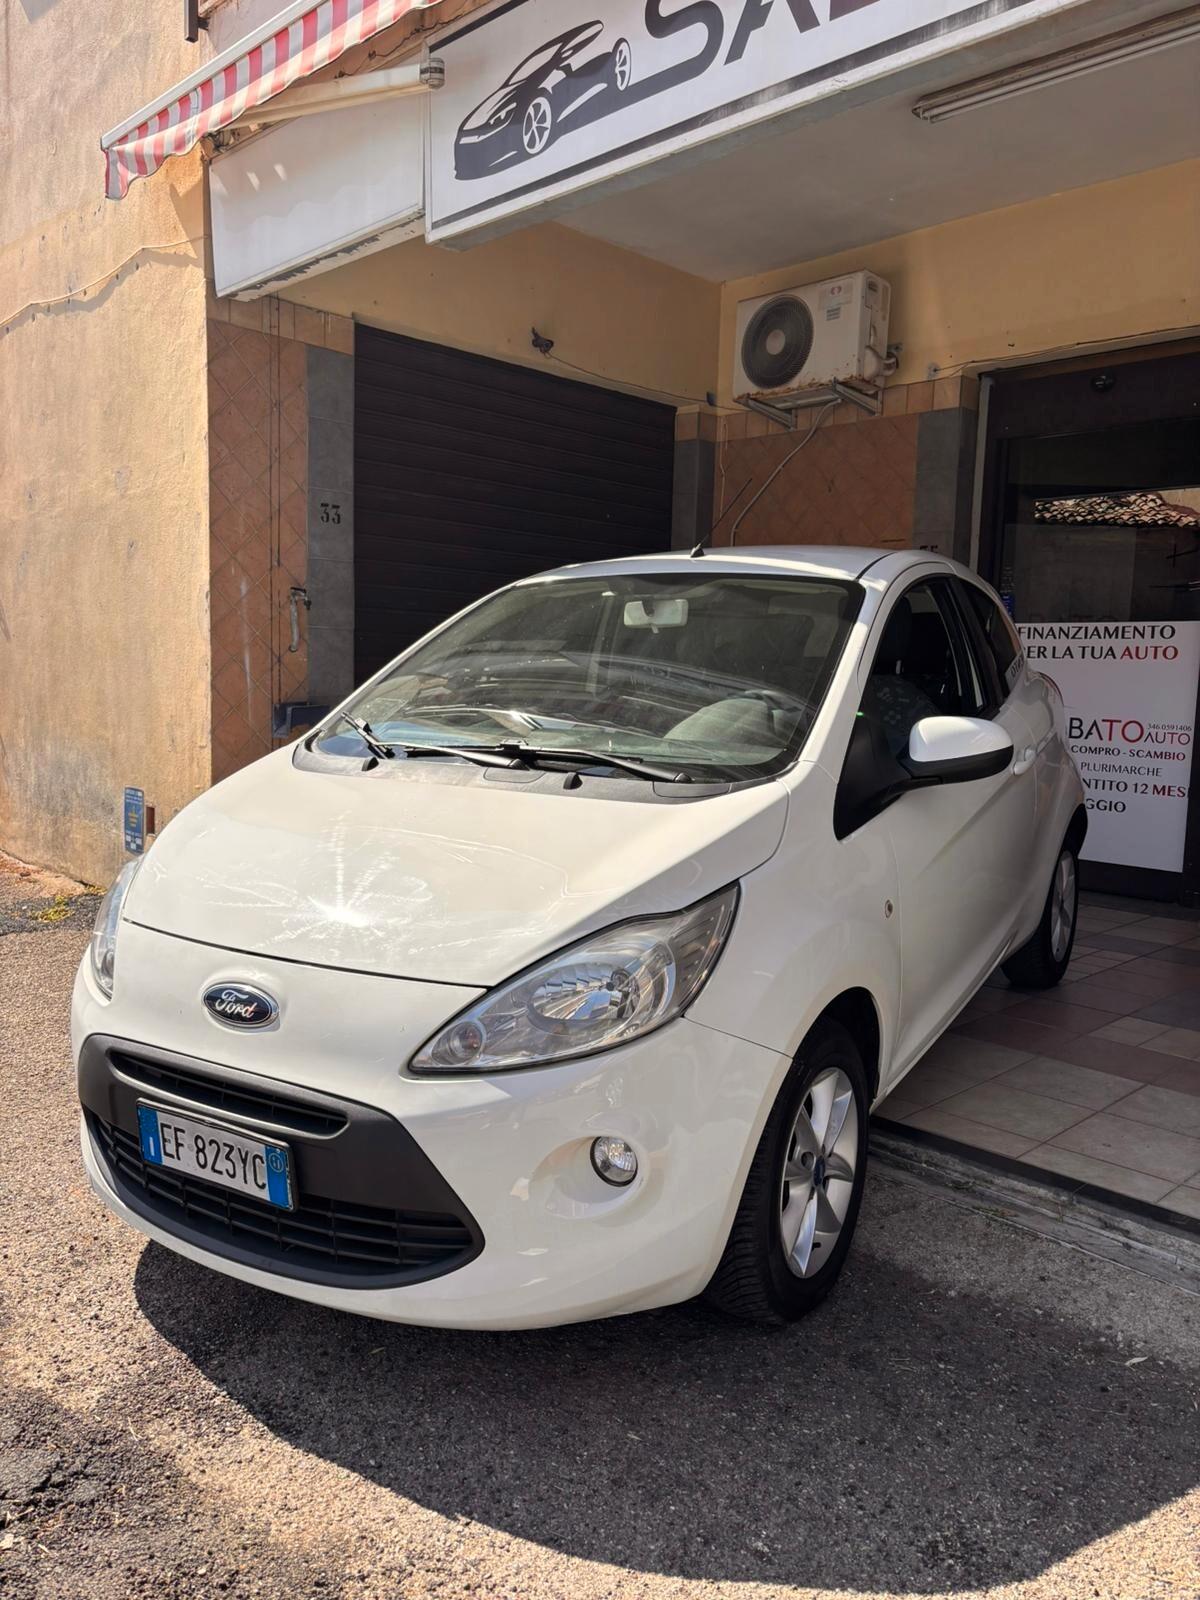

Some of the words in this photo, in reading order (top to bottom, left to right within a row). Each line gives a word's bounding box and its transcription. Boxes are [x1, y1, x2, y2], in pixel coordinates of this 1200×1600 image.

[320, 502, 341, 525] 33
[1018, 624, 1176, 640] FINANZIAMENTO
[1024, 645, 1047, 660] ER
[1052, 645, 1074, 660] LA
[1078, 645, 1117, 660] TUA
[1120, 645, 1179, 660] AUTO
[1066, 717, 1144, 743] BATO
[1144, 731, 1191, 746] AUTO
[1071, 744, 1121, 757] COMPRO
[1129, 748, 1186, 761] SCAMBIO
[1080, 761, 1163, 777] PLURIMARCHE
[1133, 782, 1149, 795] 12
[215, 989, 257, 1018] Ford
